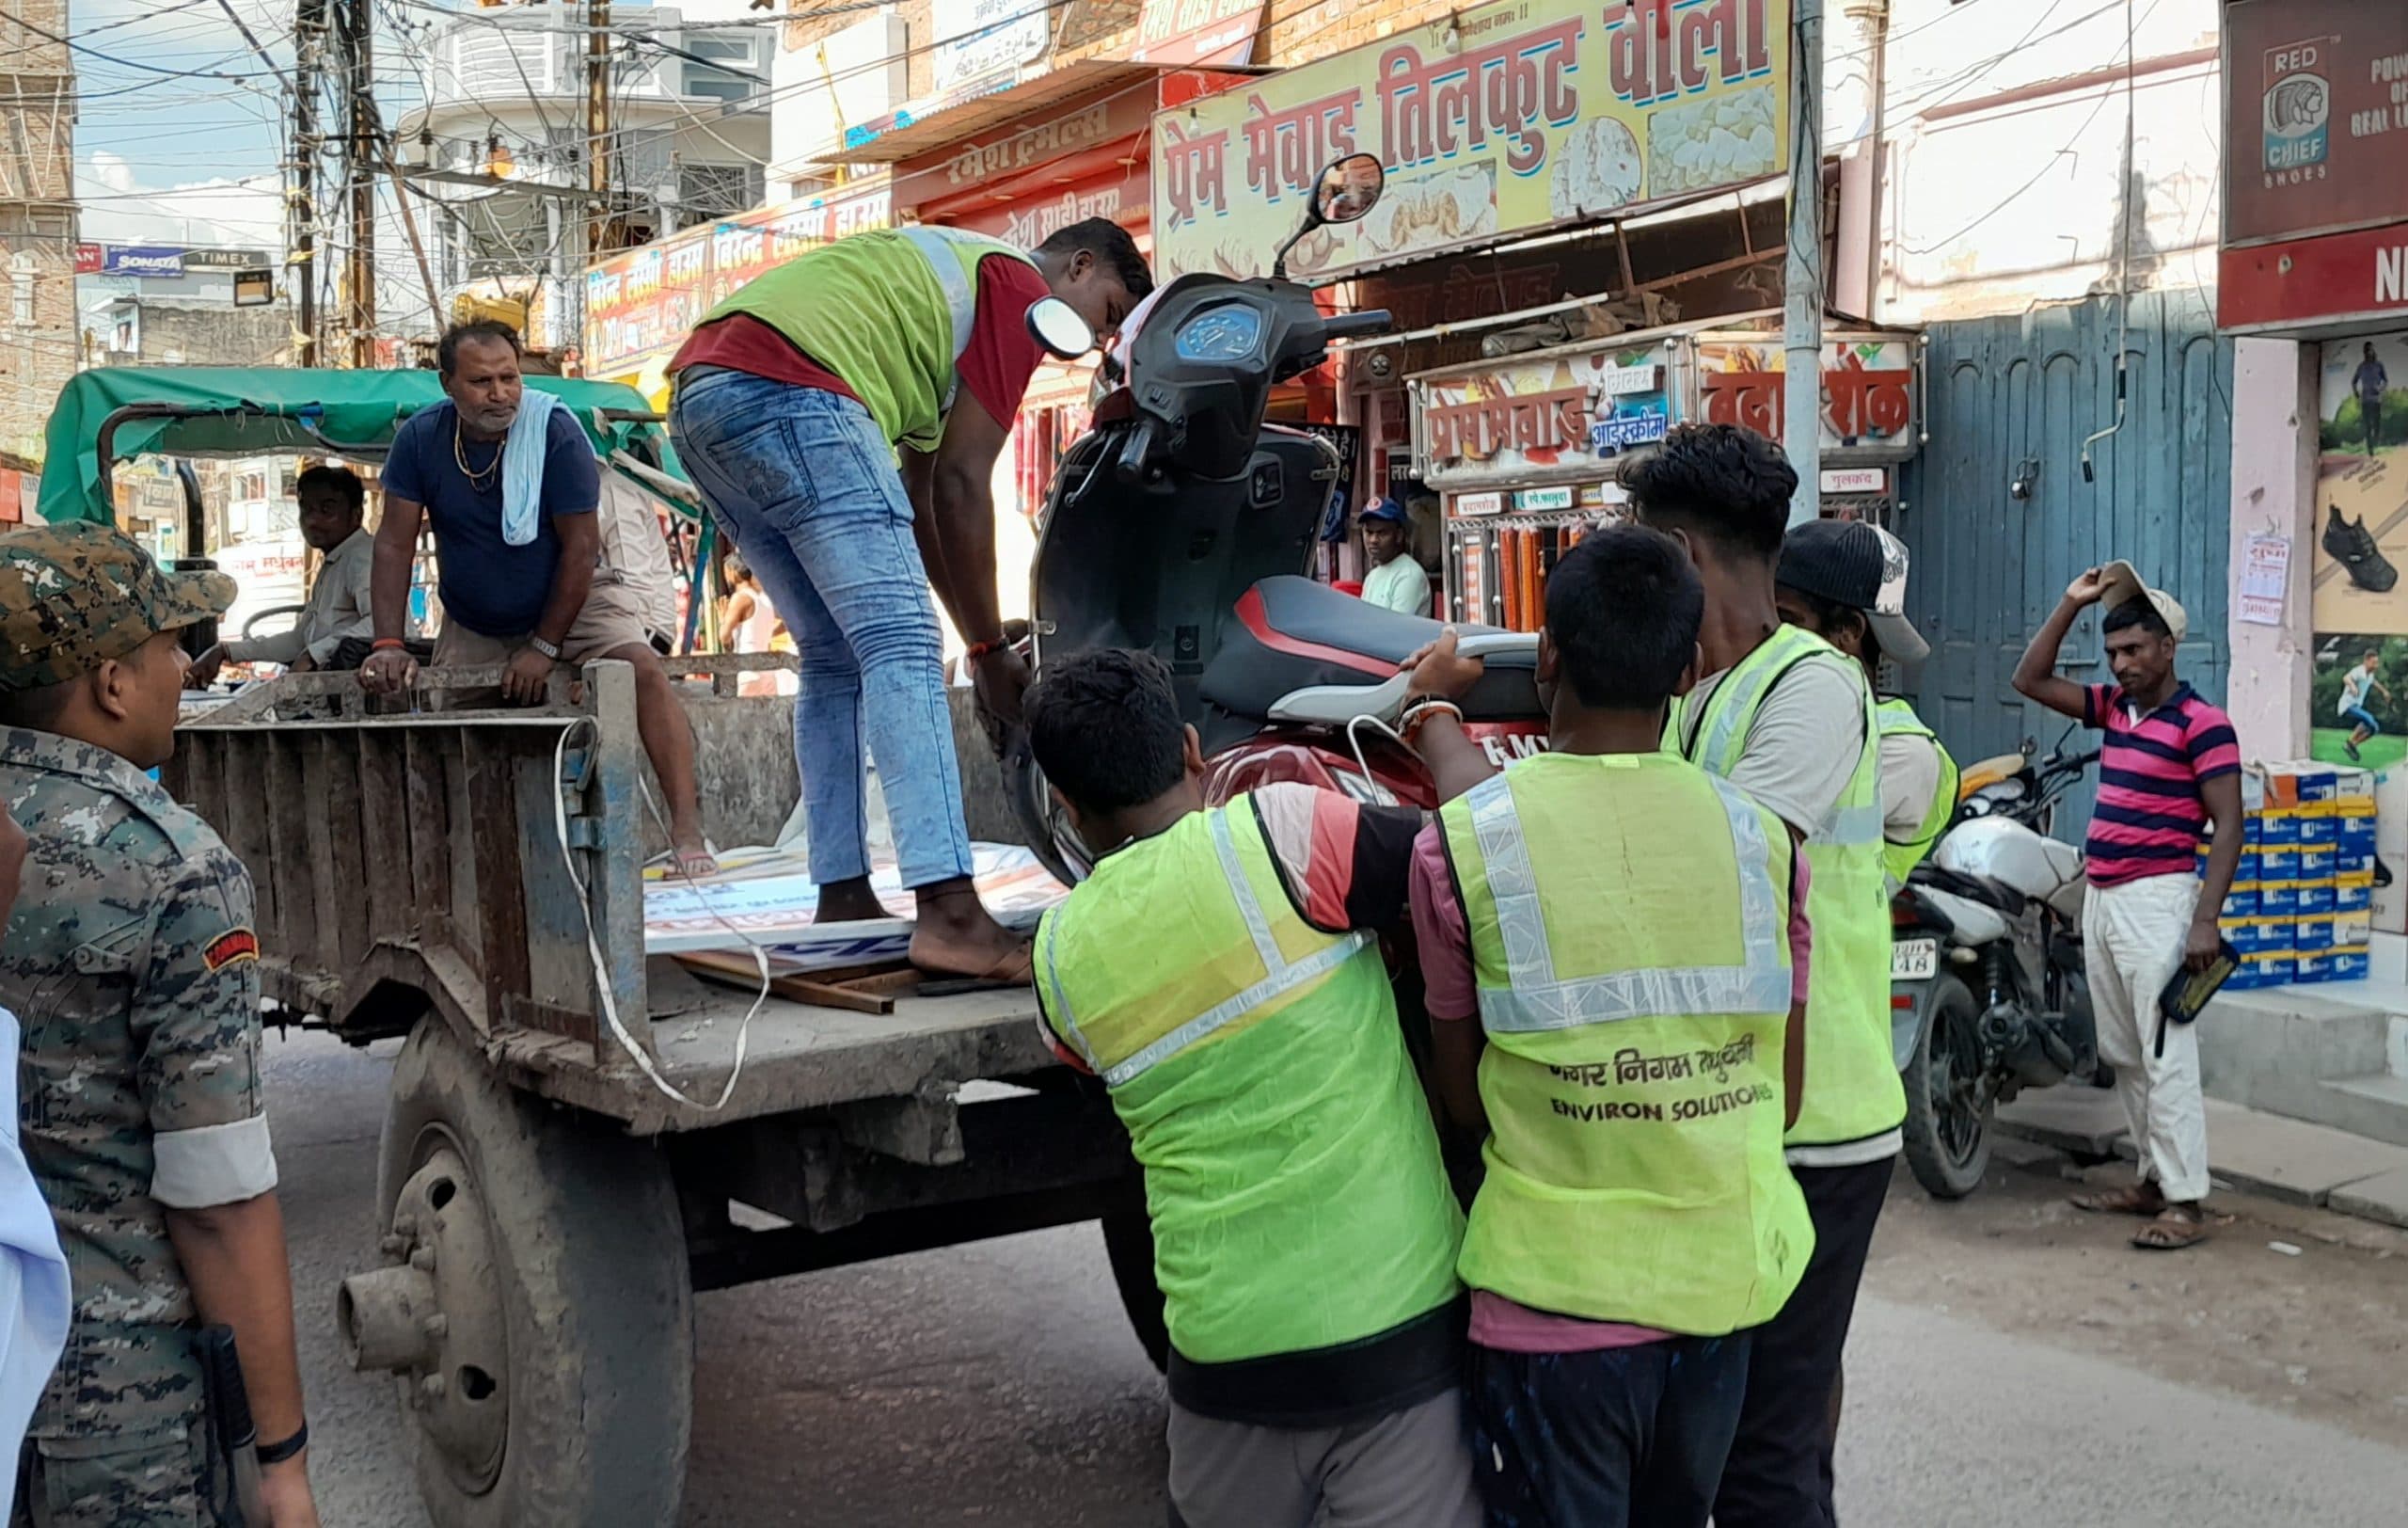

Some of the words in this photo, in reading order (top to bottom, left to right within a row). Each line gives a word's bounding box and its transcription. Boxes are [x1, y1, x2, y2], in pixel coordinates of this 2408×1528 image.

[2274, 47, 2318, 73] RED
[1165, 119, 1229, 231] प्रेम
[1375, 15, 1586, 178] तिलकुट
[2352, 106, 2390, 138] REAL
[947, 143, 1011, 185] रमेश
[2268, 137, 2322, 167] CHIEF
[2264, 164, 2326, 189] SHOES
[118, 255, 182, 271] SONATA
[198, 251, 251, 265] TIMEX
[1592, 406, 1666, 454] आईस्क्रीम
[1613, 1048, 1692, 1084] निगम
[1550, 1097, 1664, 1122] ENVIRON
